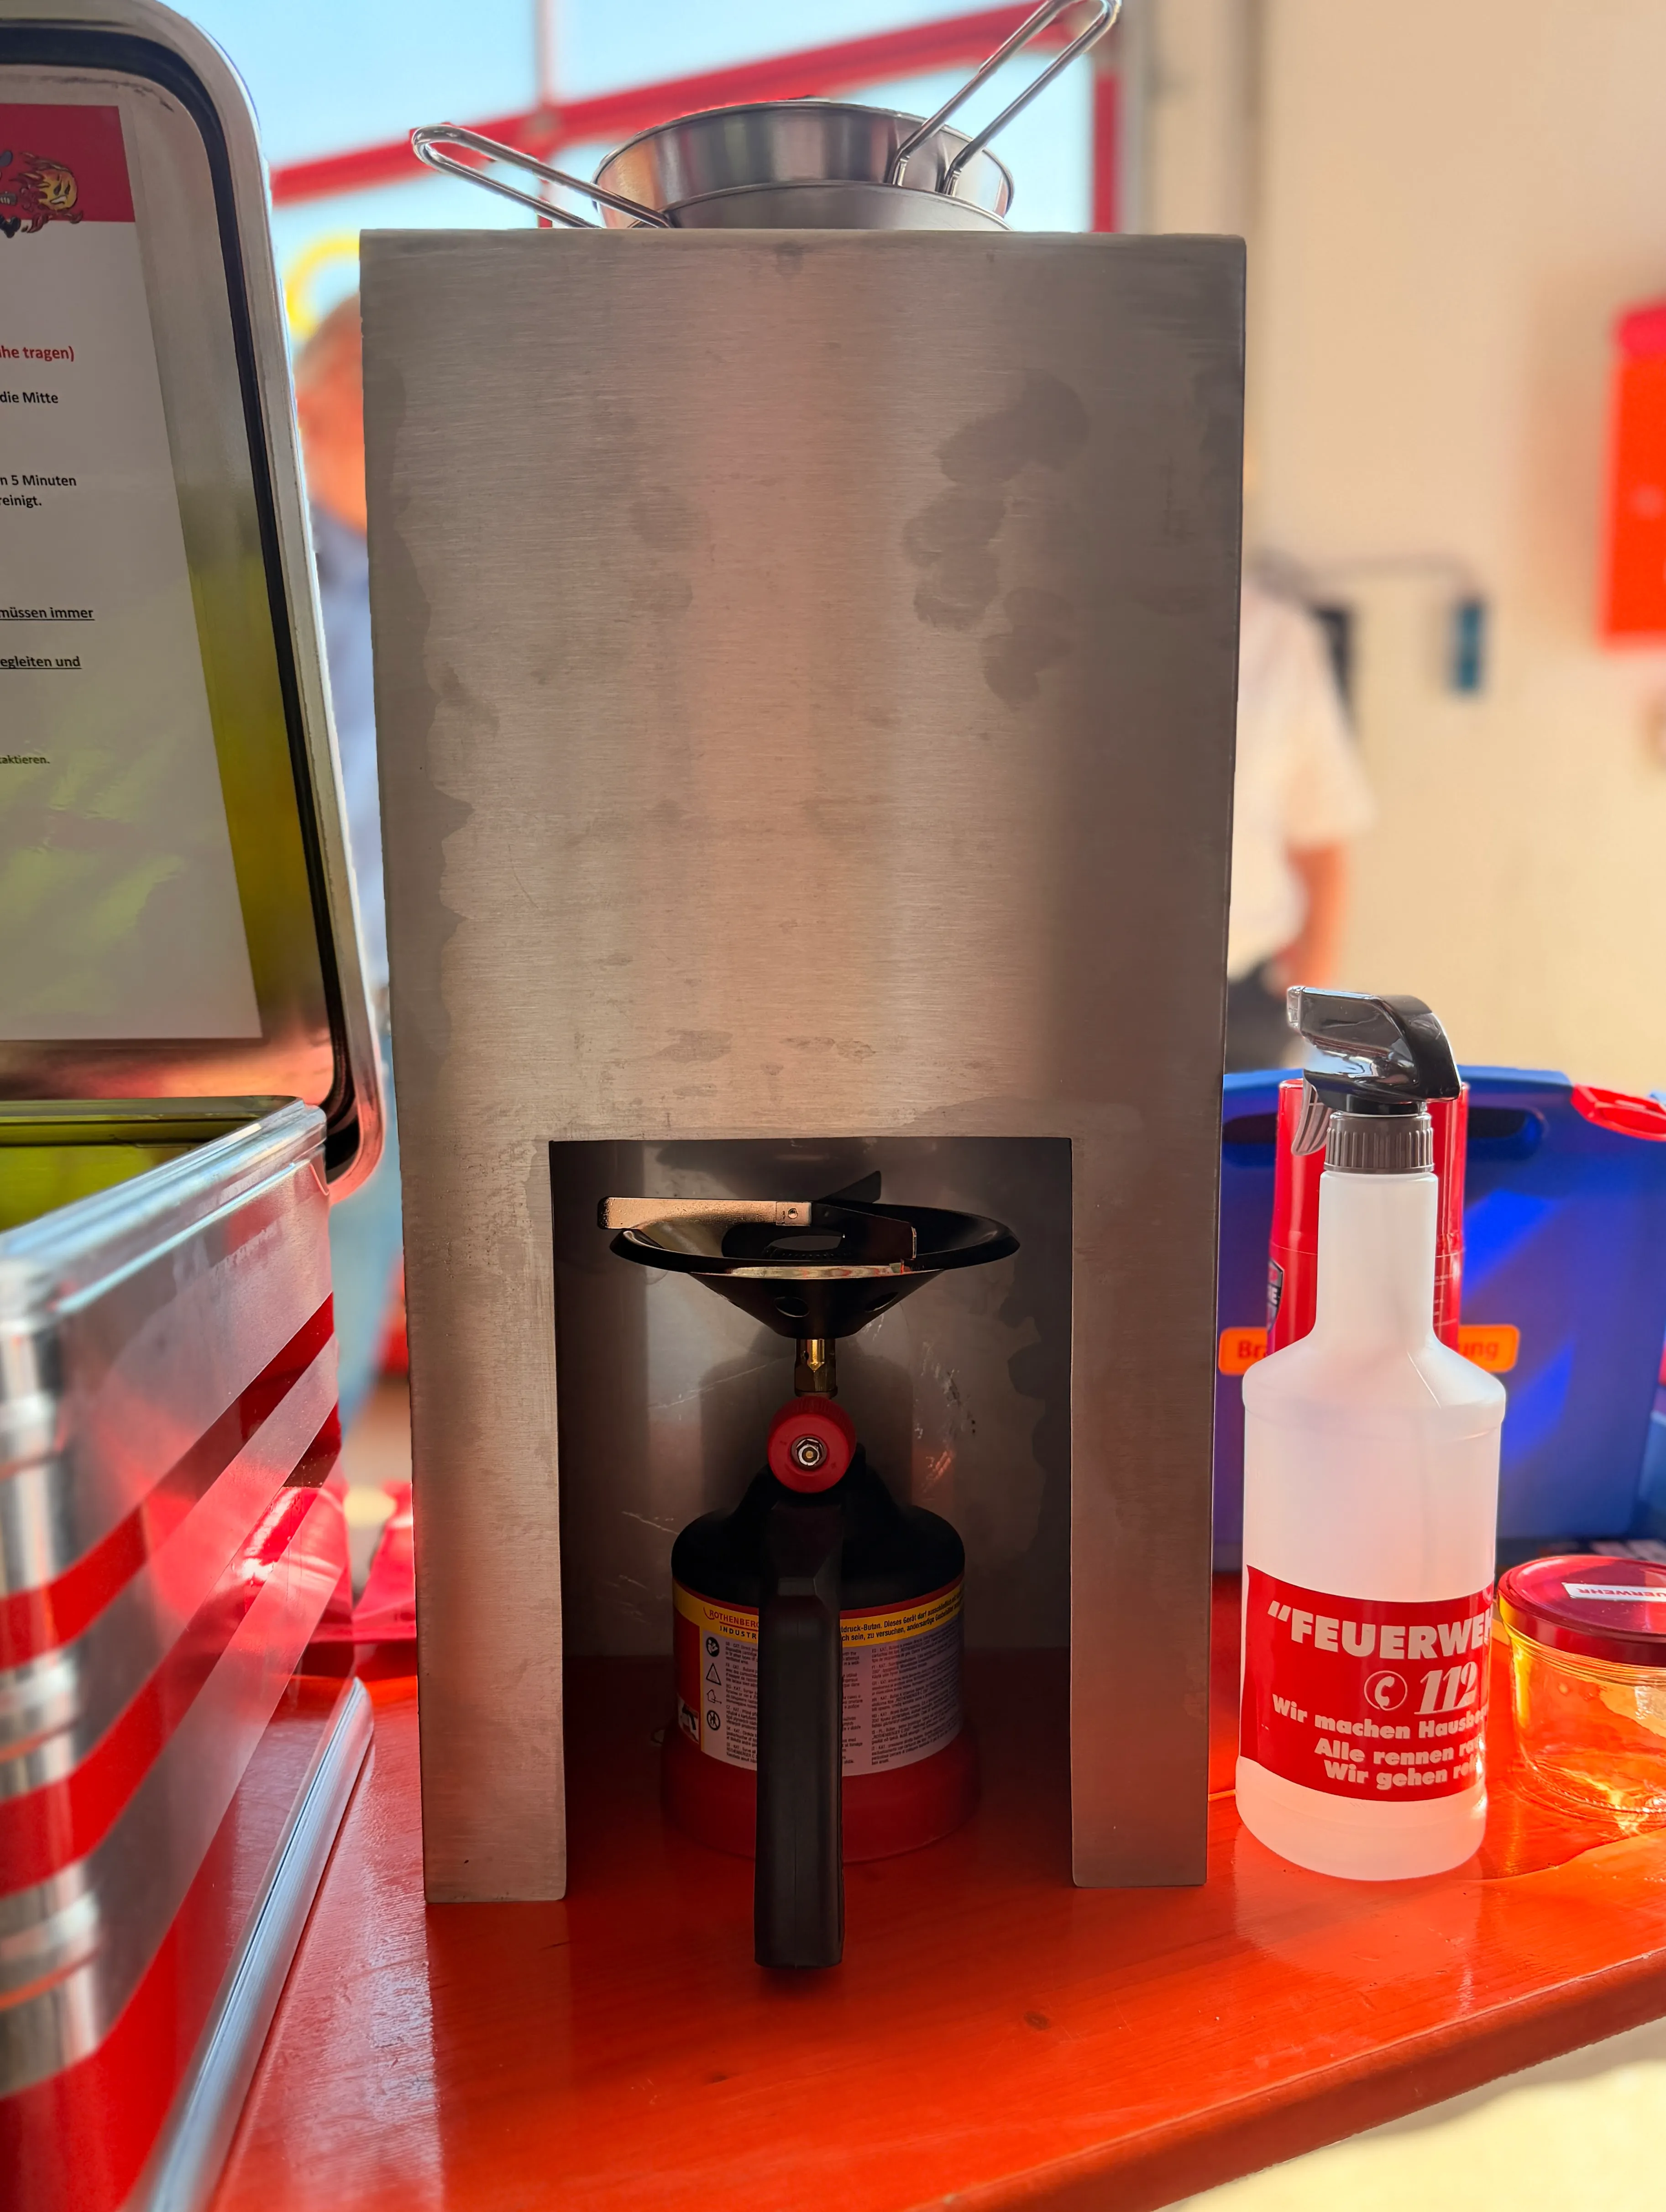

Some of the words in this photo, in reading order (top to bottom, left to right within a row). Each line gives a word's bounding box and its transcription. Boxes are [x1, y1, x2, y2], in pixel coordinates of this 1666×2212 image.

[23, 346, 74, 362] tragen)
[0, 392, 19, 403] die
[22, 392, 58, 404] Mitte
[11, 475, 19, 486] 5
[22, 475, 77, 486] Minuten
[50, 607, 93, 618] immer
[55, 656, 80, 667] und
[876, 1627, 906, 1638] versuchen,
[1414, 1661, 1478, 1715] 112
[1272, 1693, 1308, 1724] Wir
[1315, 1714, 1410, 1740] machen
[1314, 1738, 1365, 1763] Alle
[1373, 1746, 1454, 1766] rennen
[1324, 1759, 1368, 1784] Wir
[1376, 1768, 1448, 1791] gehen
